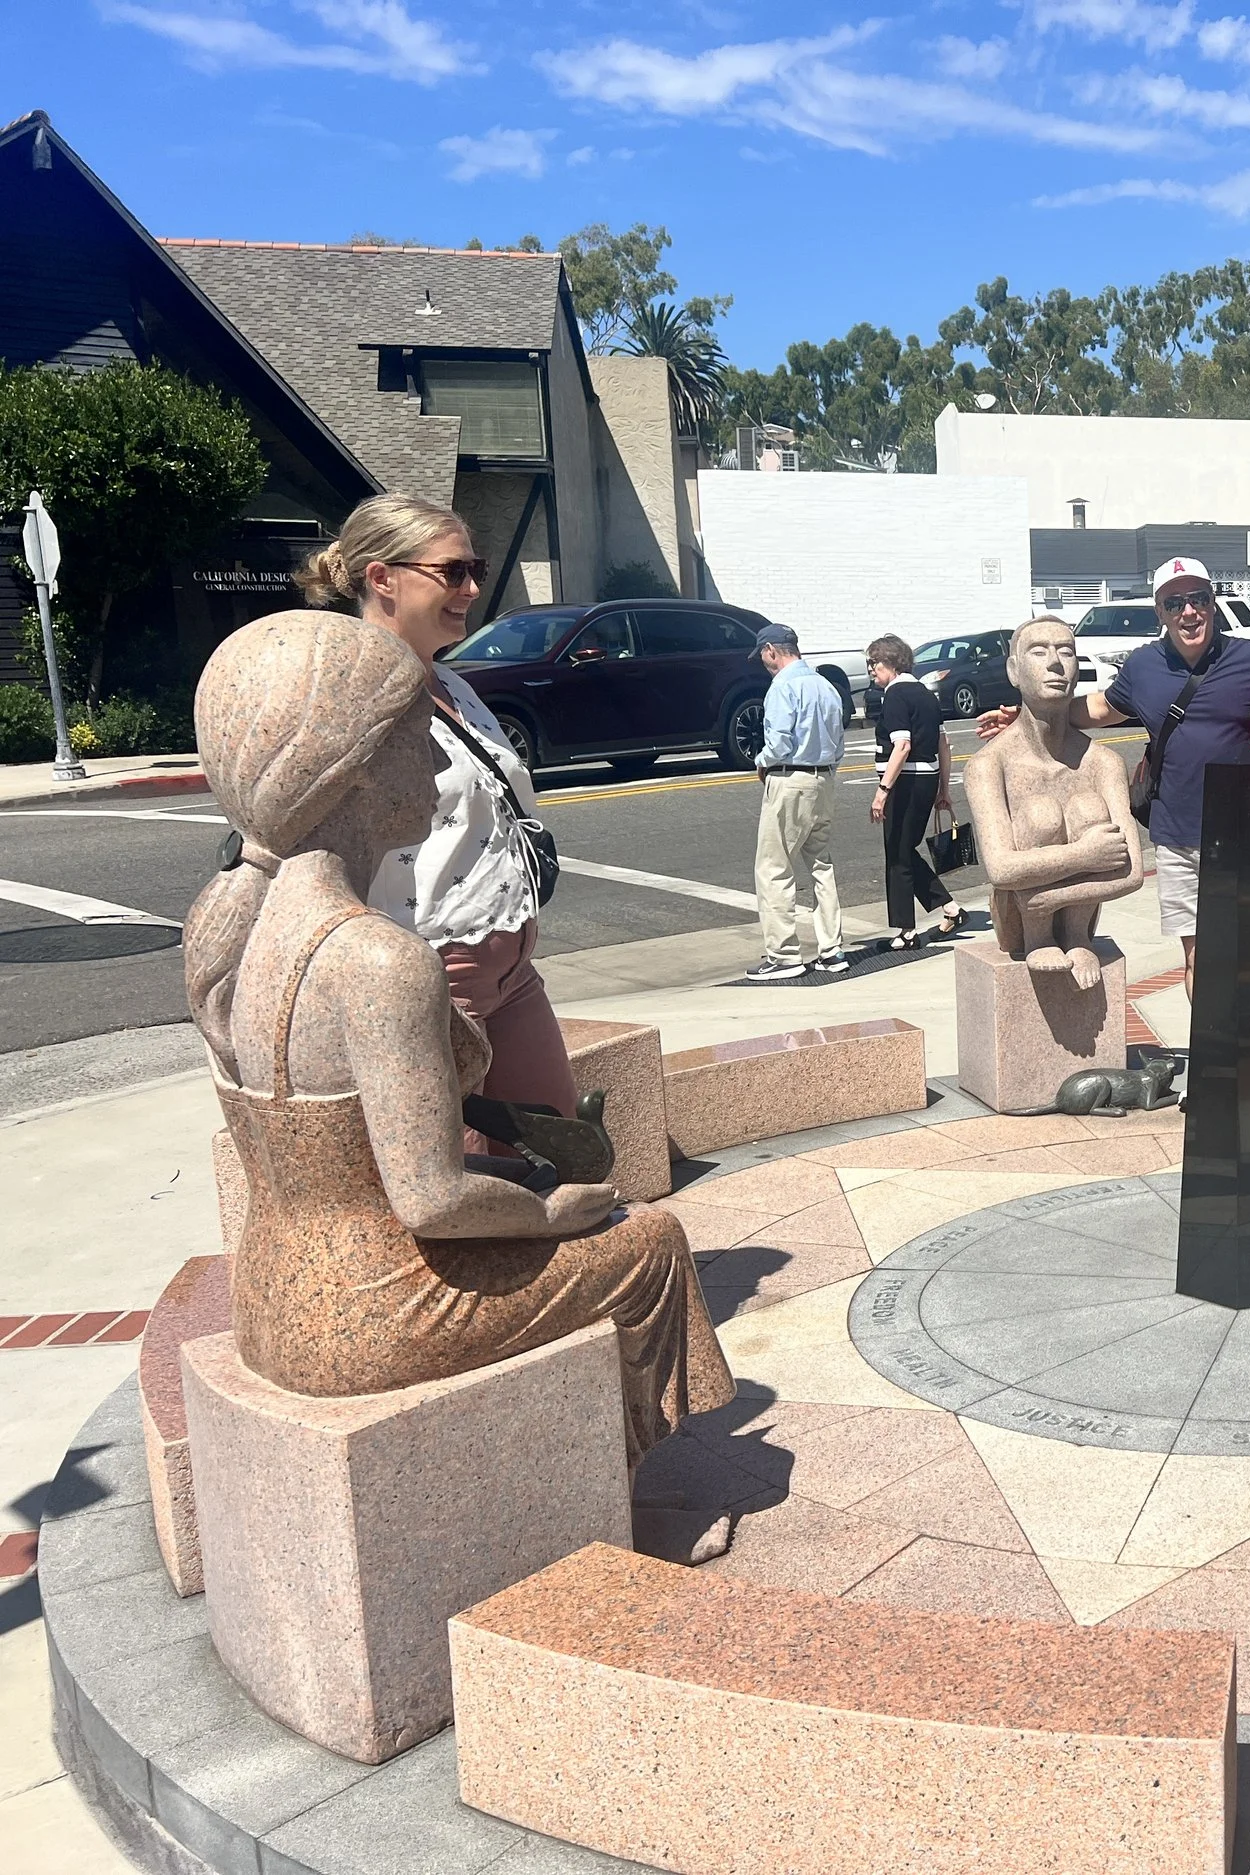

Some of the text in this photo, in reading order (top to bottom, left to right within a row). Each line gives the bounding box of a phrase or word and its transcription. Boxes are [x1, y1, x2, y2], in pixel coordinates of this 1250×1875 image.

[192, 571, 258, 582] CALIFORNIA
[1173, 560, 1186, 573] A
[237, 584, 287, 592] CONSTRUCTION
[918, 1225, 979, 1253] PEACE
[871, 1279, 907, 1327] FREEDOM
[888, 1348, 960, 1389] HEALTH
[1011, 1407, 1134, 1438] JUSTICE
